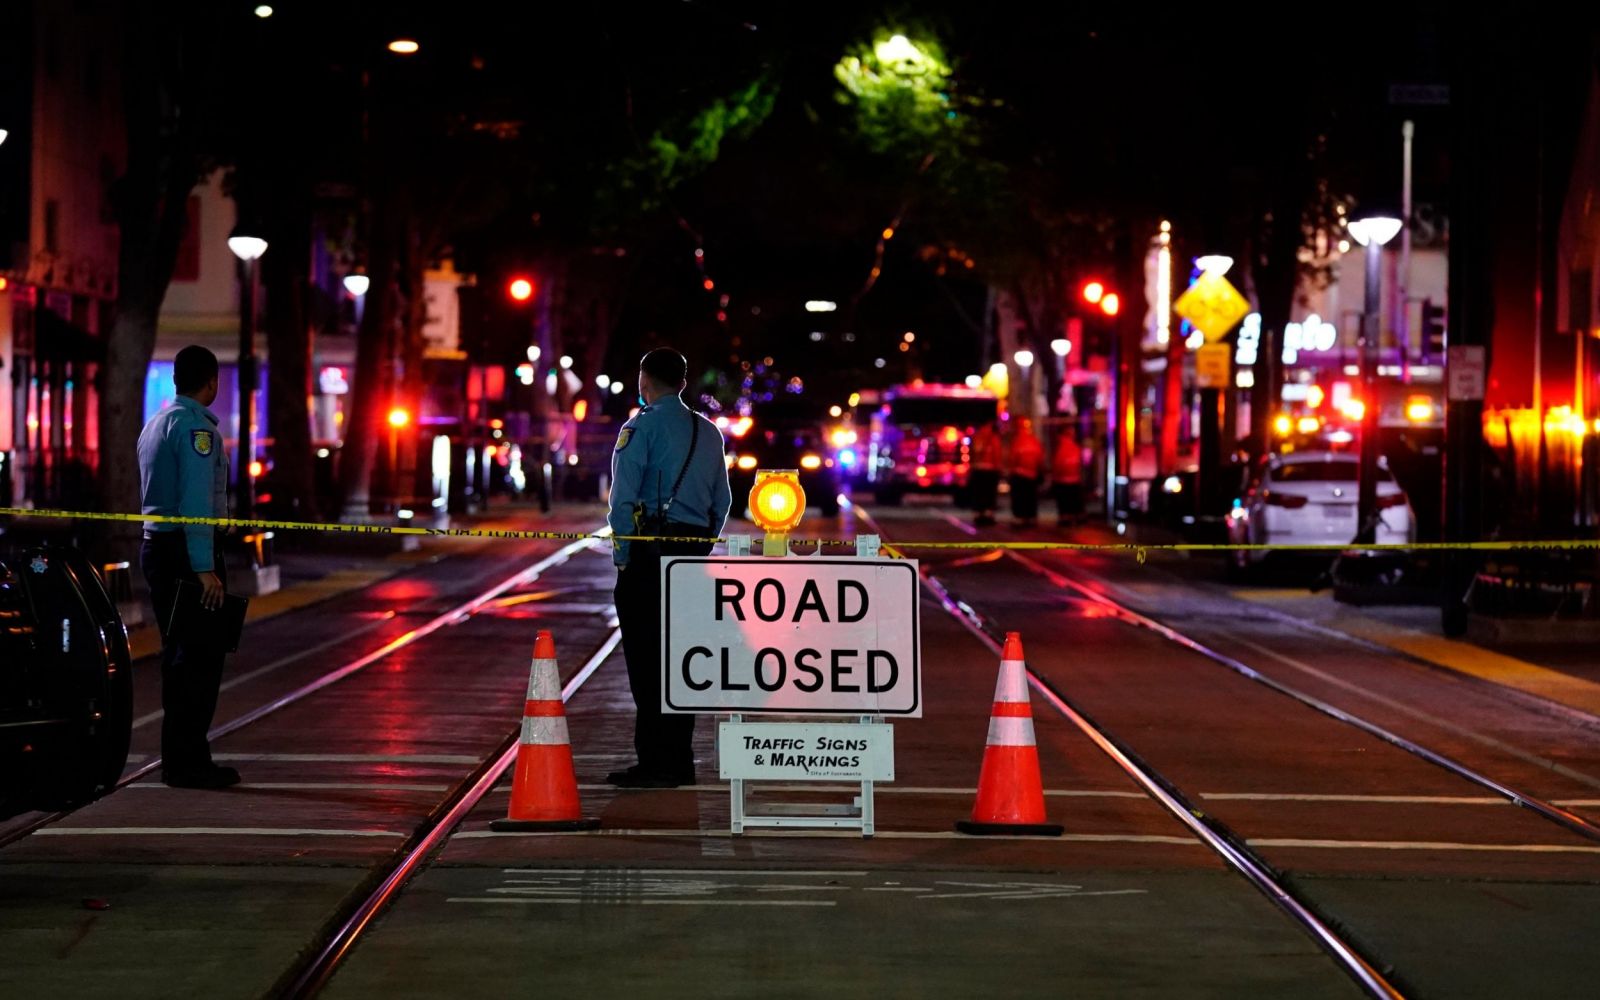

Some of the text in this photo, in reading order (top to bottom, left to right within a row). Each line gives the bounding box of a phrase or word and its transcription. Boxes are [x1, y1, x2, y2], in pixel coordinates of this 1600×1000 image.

[714, 577, 869, 623] ROAD
[681, 645, 899, 693] CLOSED
[754, 754, 765, 766] &
